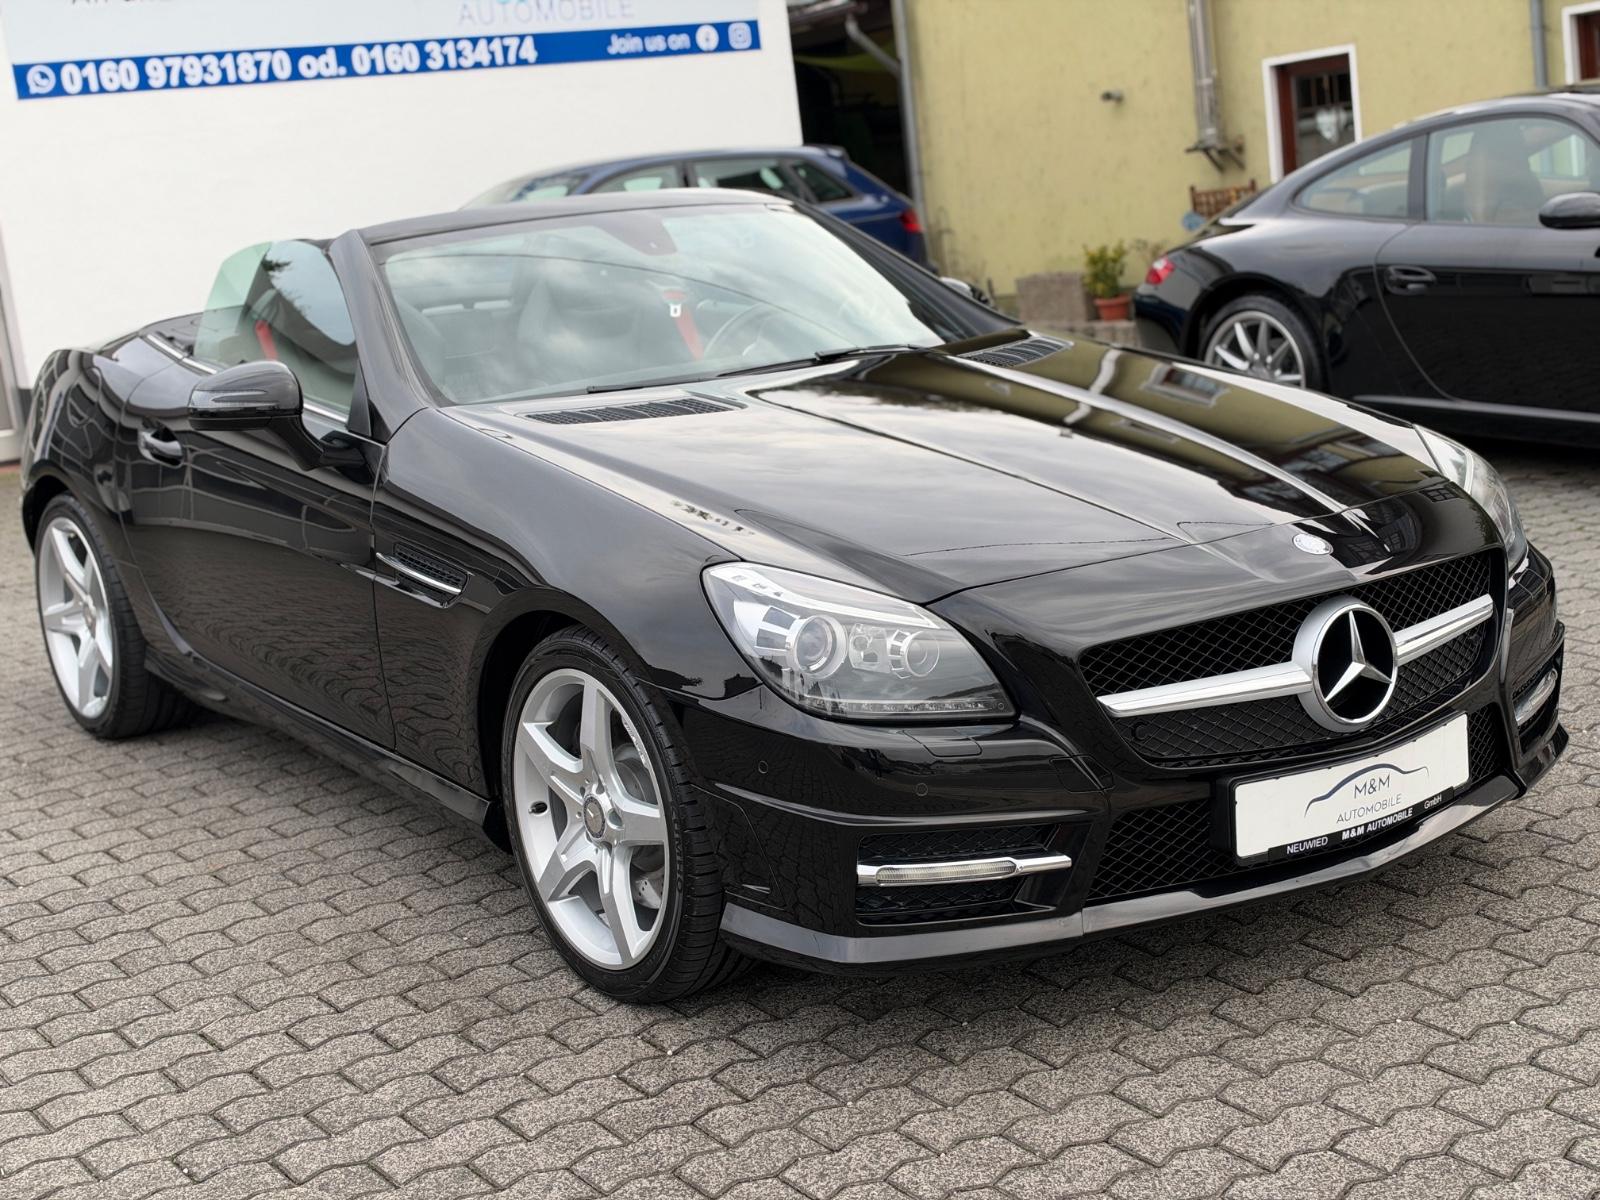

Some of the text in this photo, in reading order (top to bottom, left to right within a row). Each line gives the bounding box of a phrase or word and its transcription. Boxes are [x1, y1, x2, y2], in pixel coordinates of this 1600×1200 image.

[458, 0, 635, 27] AUTOMOBILE
[607, 31, 691, 55] Join us on
[60, 34, 538, 95] 0160 97931870 od. 0160 3134174
[1353, 772, 1390, 799] M&M
[1336, 793, 1402, 824] AUTOMOBILE
[1286, 794, 1442, 854] NEUWIED M&M AUTOMOBILE GmbH
